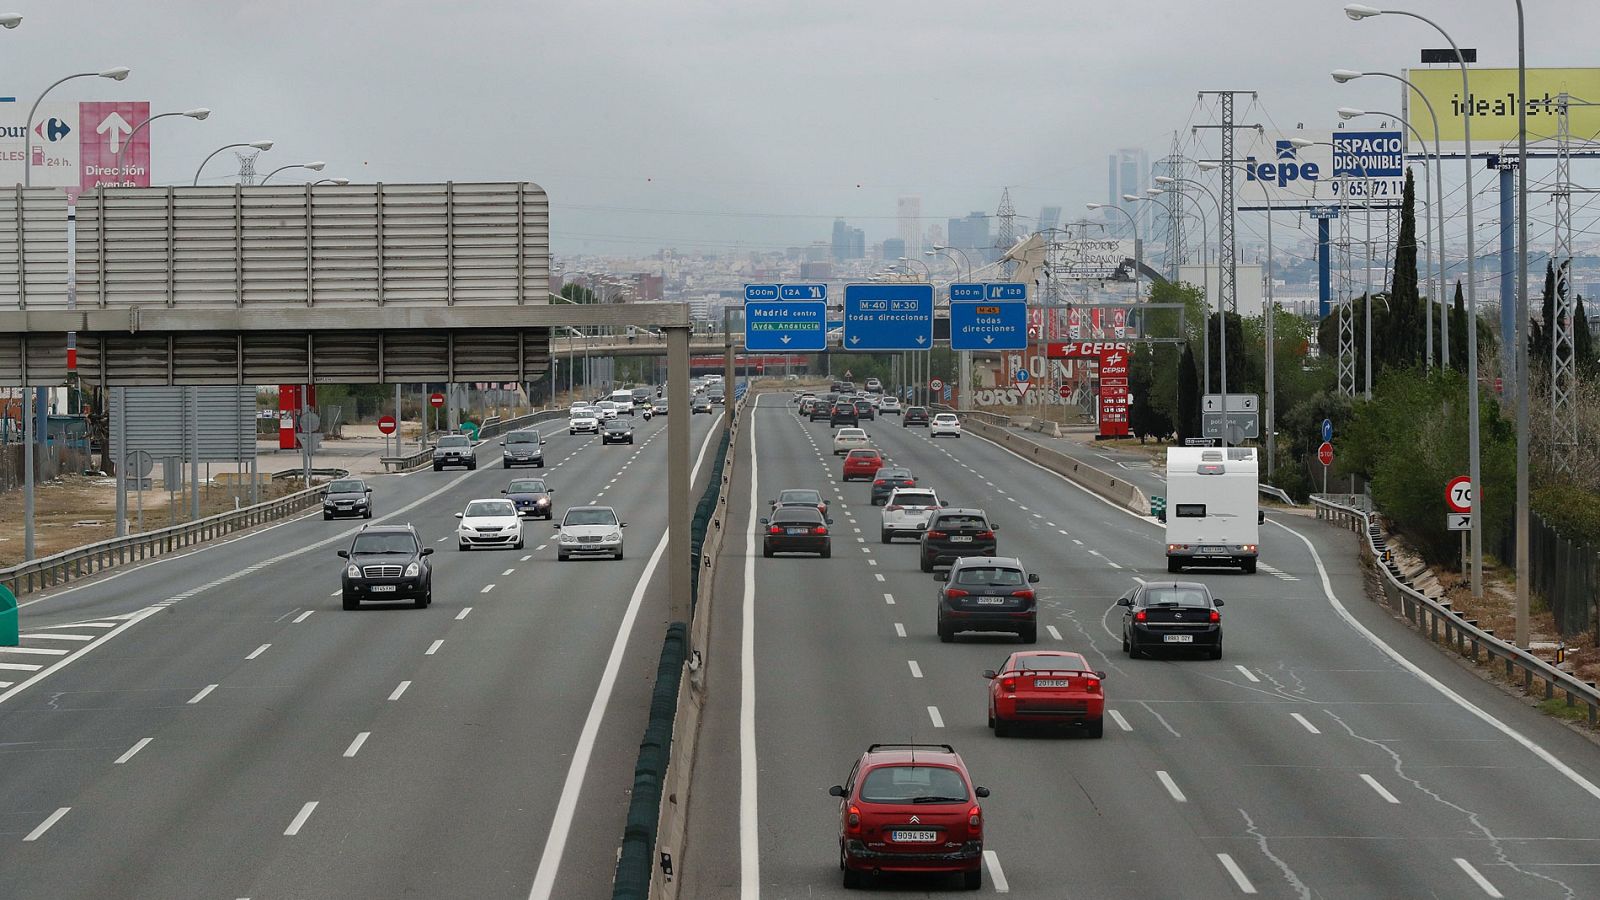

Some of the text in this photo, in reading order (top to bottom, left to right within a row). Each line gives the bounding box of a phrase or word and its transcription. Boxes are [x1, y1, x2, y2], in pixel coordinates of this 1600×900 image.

[1334, 138, 1402, 153] ESPACIO
[47, 158, 60, 167] 24
[1246, 156, 1320, 188] iepe
[861, 301, 886, 309] M-40
[892, 301, 917, 309] M-30
[754, 309, 788, 317] Madrid
[848, 313, 929, 321] todas direcciones
[962, 324, 1015, 332] direcciones
[898, 832, 917, 840] 9094
